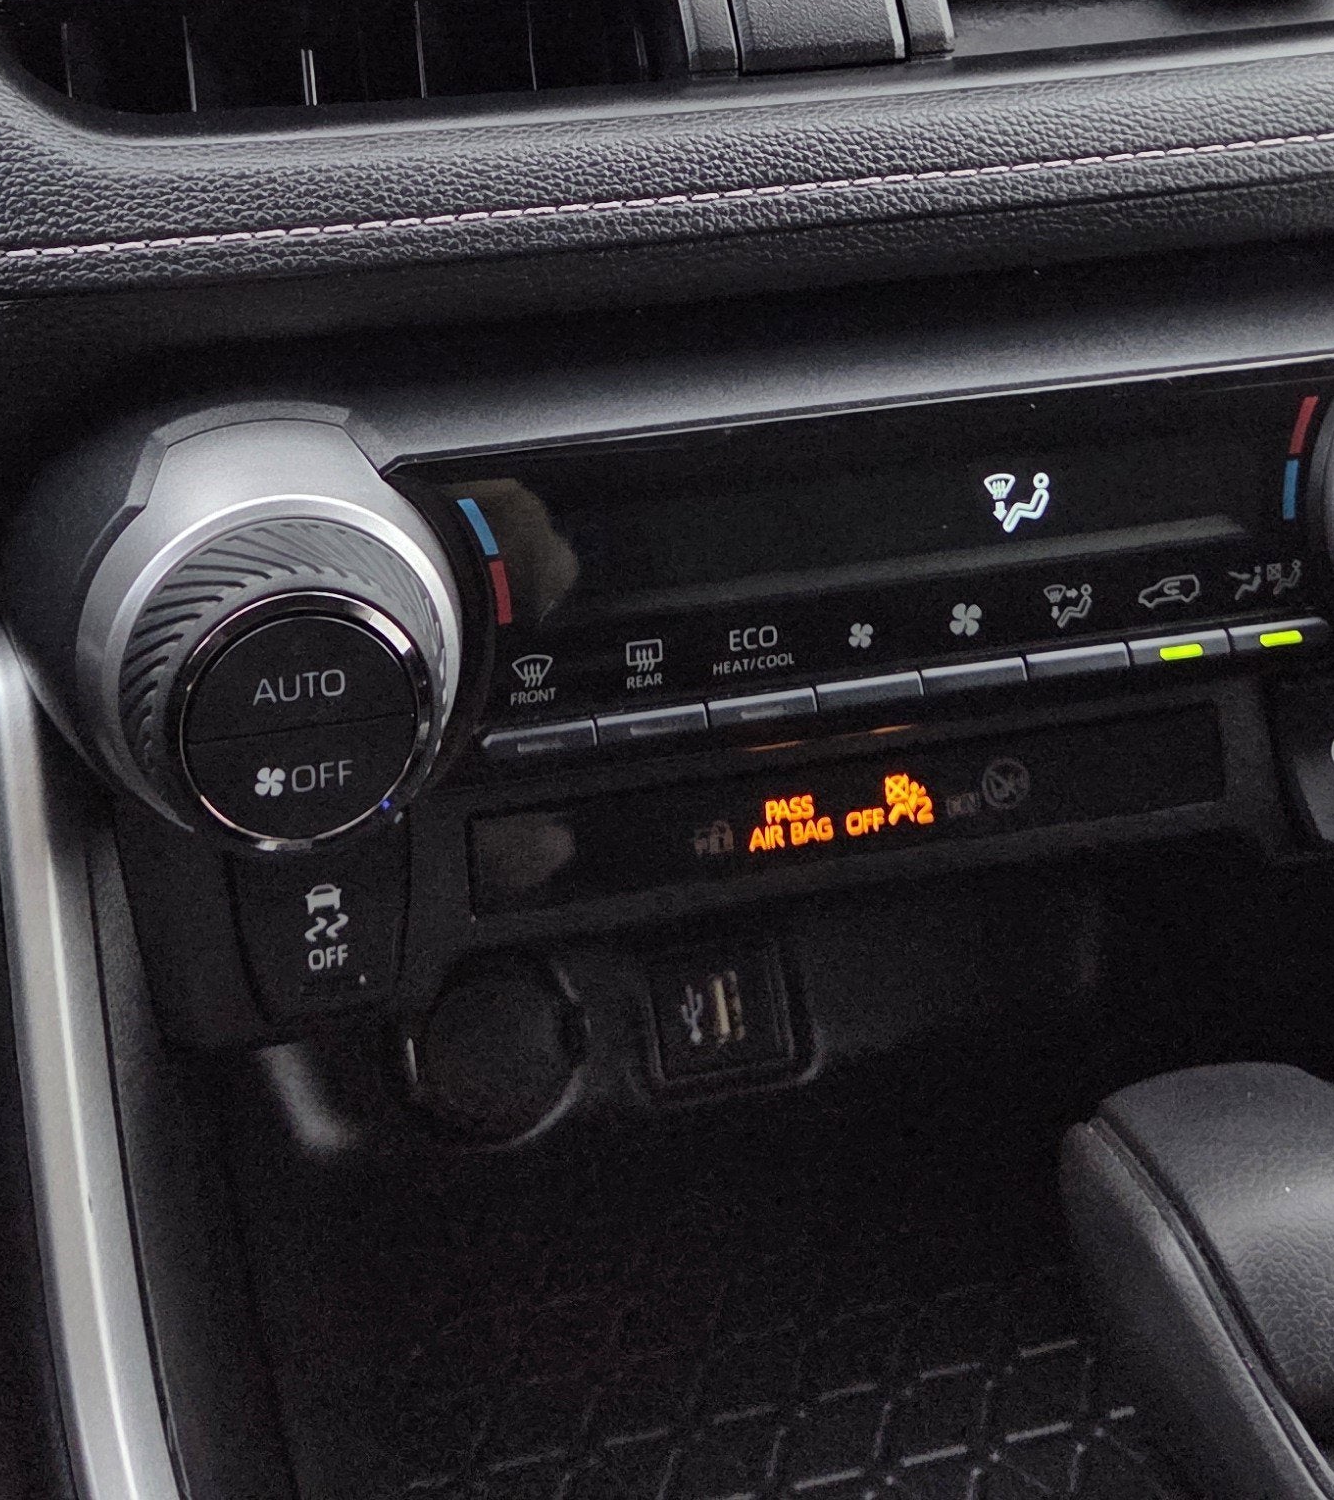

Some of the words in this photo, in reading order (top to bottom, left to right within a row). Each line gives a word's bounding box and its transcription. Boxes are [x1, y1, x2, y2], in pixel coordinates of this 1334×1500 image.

[728, 625, 778, 652] ECO
[712, 652, 795, 677] HEAT/COOL
[252, 668, 346, 707] AUTO
[626, 671, 663, 690] REAR
[510, 687, 557, 707] FRONT
[291, 760, 354, 794] OFF
[765, 794, 815, 824] PASS
[748, 823, 785, 852] AIR
[790, 816, 834, 846] BAG
[845, 807, 884, 837] OFF
[308, 943, 349, 972] OFF
